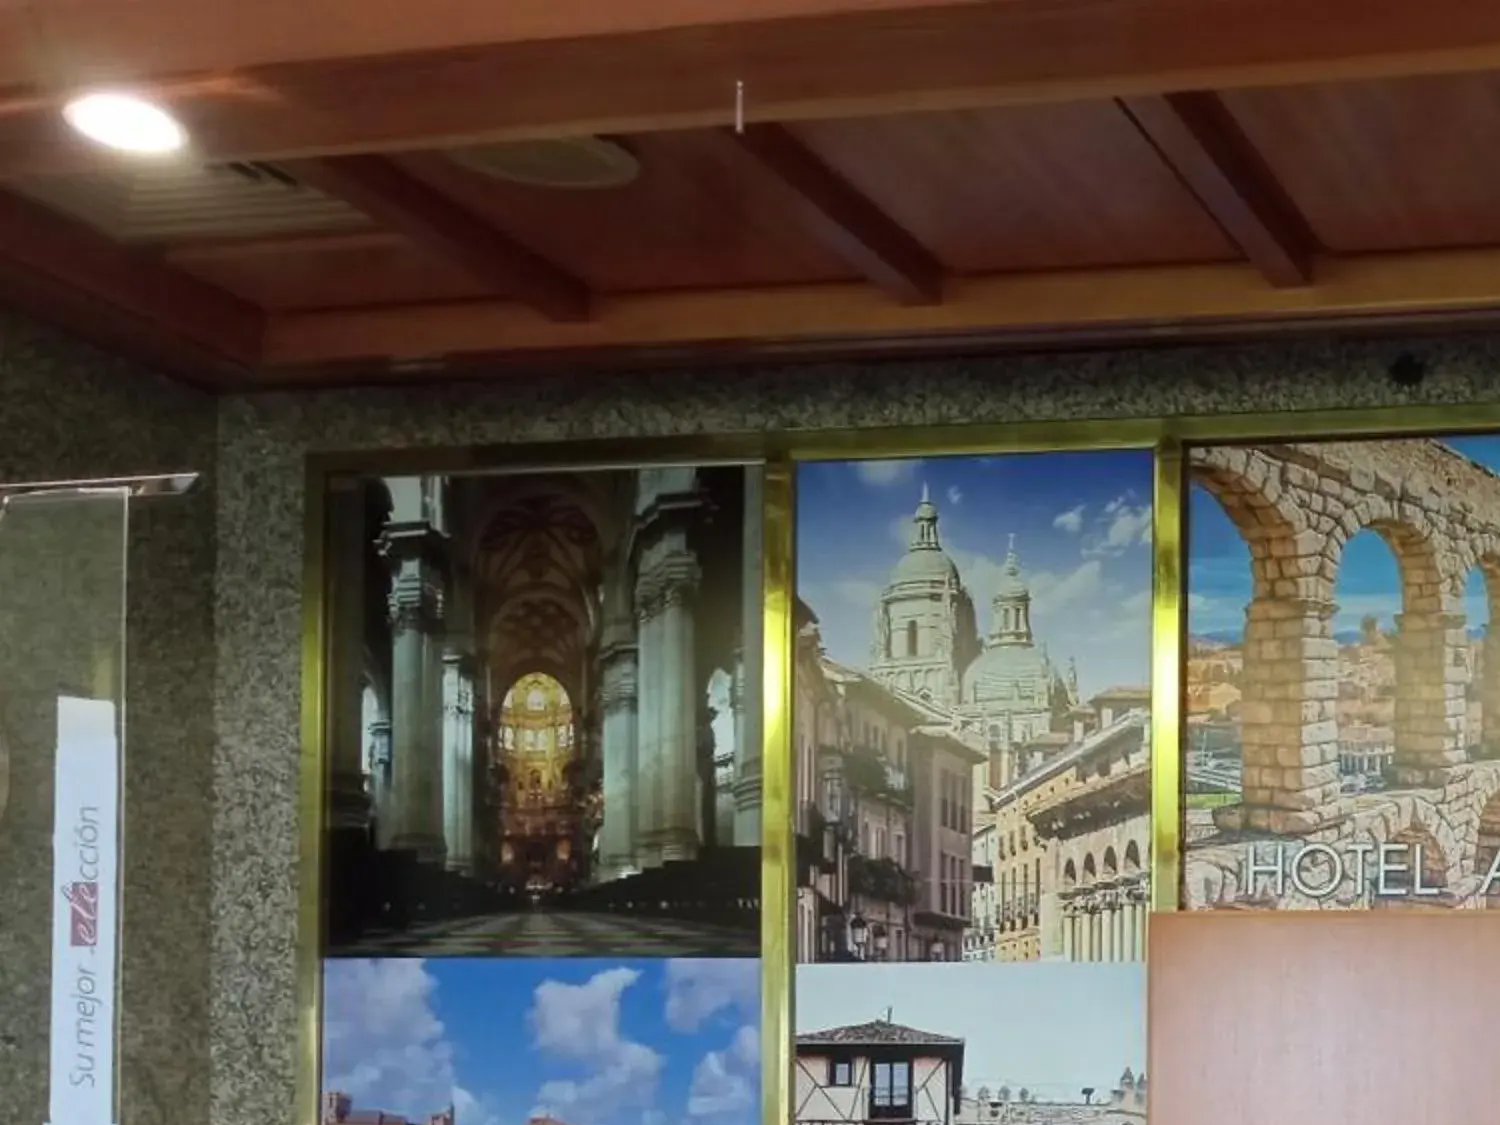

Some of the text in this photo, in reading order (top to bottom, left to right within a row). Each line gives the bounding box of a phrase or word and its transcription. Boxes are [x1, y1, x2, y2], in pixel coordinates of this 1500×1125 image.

[1245, 840, 1441, 897] HOTEL
[75, 967, 103, 1048] mejor
[69, 1056, 95, 1088] Su
